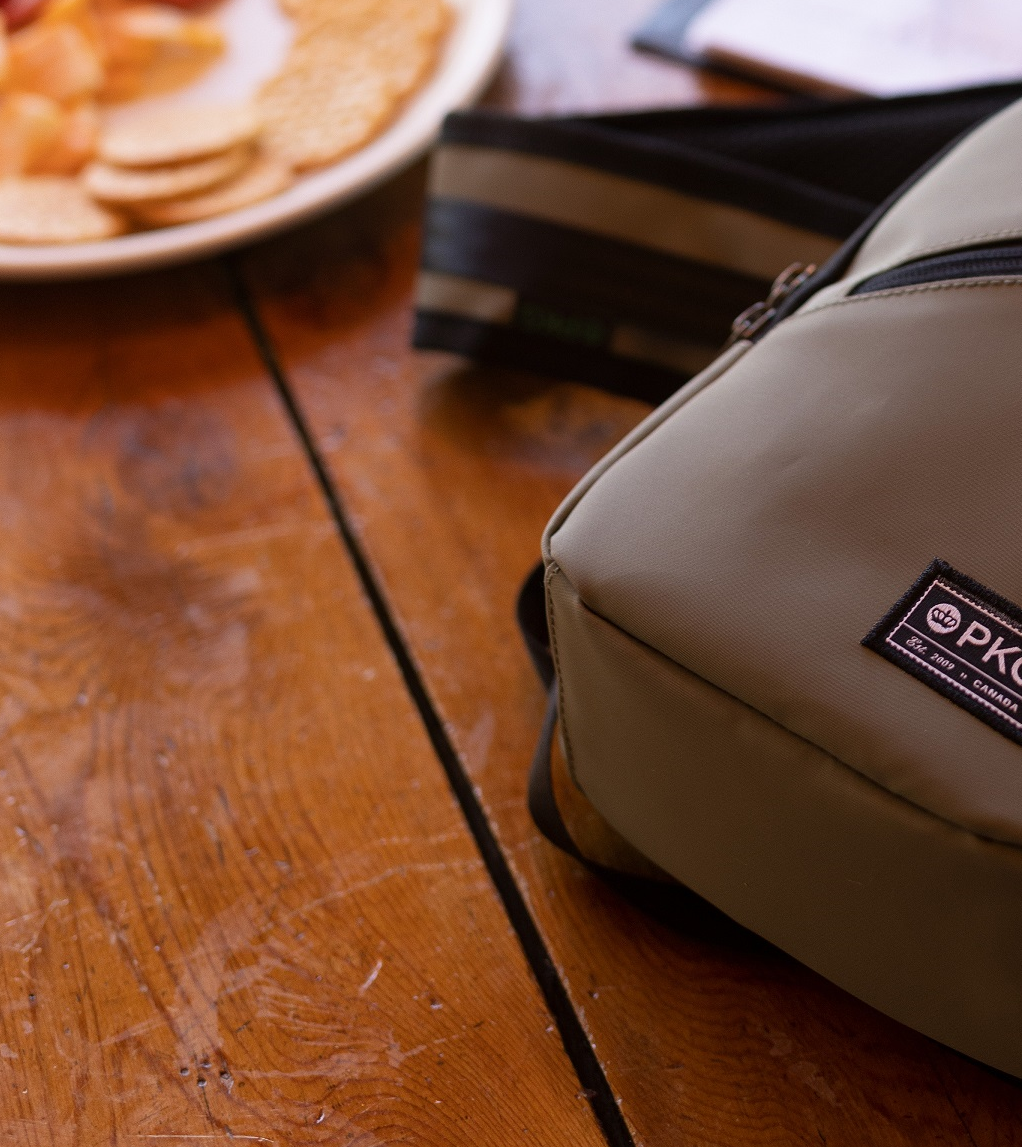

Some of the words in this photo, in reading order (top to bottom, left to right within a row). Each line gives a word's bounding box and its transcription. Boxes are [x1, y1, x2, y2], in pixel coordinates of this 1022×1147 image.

[905, 635, 926, 655] Est.
[930, 652, 955, 670] 2009
[973, 679, 1019, 713] CANADA
